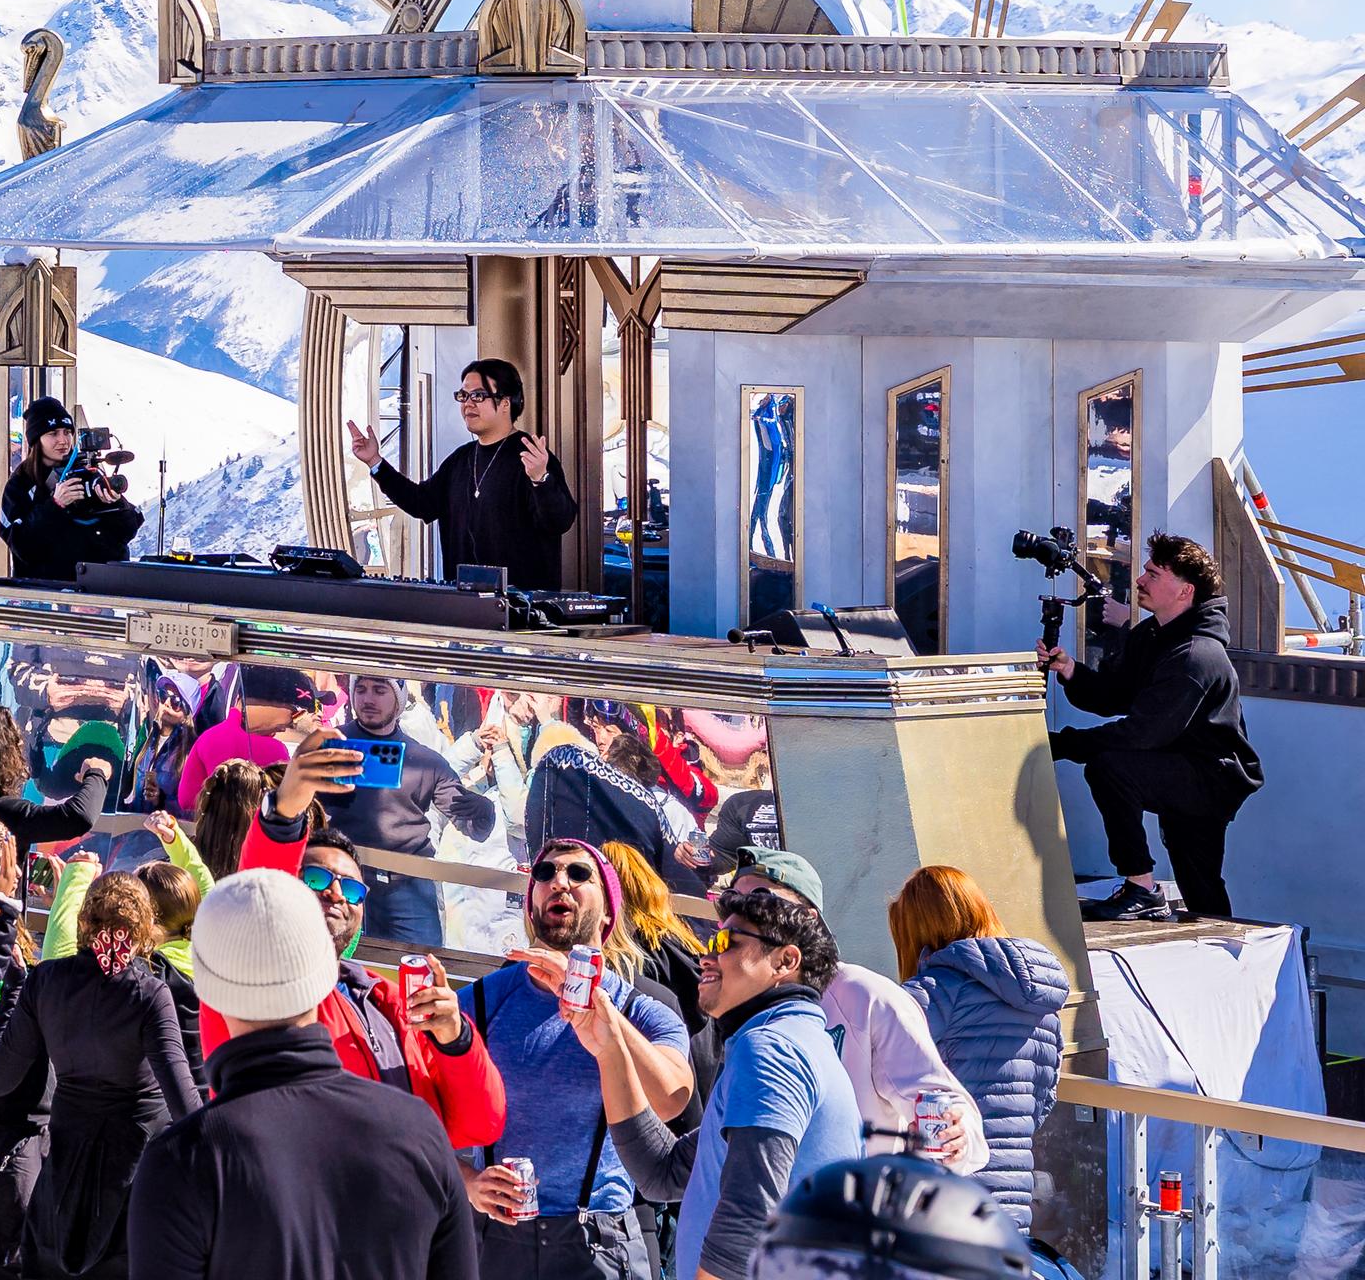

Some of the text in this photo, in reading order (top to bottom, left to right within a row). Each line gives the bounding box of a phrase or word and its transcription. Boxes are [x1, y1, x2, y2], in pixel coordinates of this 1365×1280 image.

[132, 620, 227, 640] THE REFLECTION
[155, 634, 203, 649] OF LOVE
